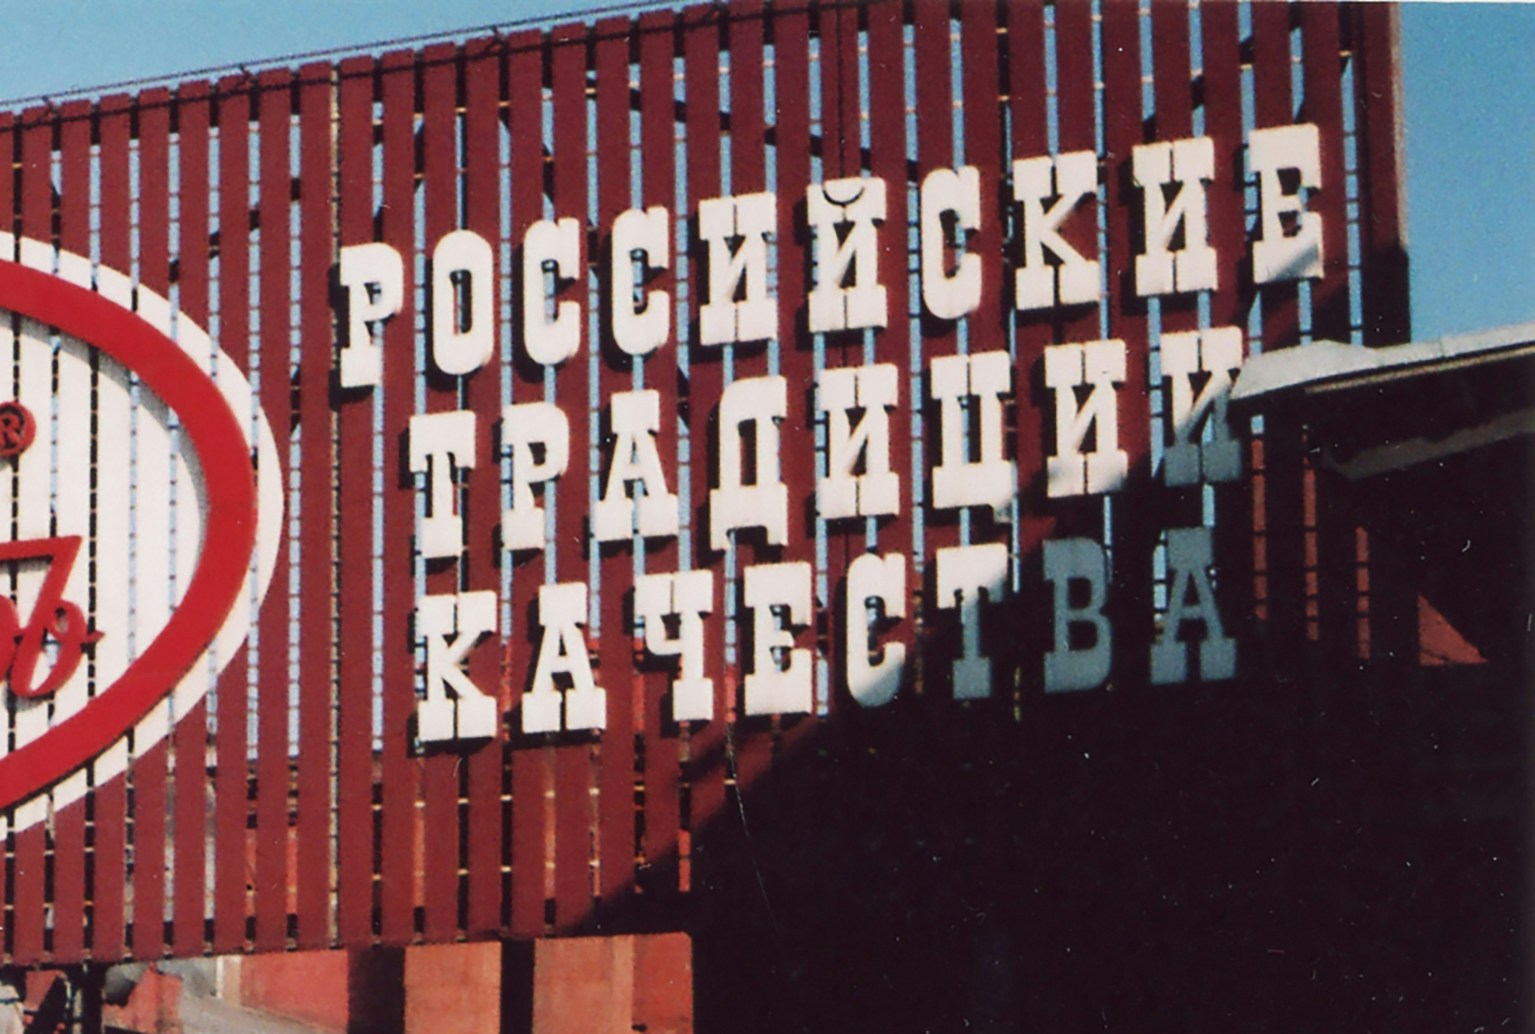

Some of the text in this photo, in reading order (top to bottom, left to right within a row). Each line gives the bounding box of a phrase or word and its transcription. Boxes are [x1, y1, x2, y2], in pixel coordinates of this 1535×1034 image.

[338, 122, 1325, 388] РОССИЙСКИЕ
[408, 326, 1243, 560] ТРАДИЦИИ
[414, 526, 1239, 742] КАЧЕСТВА
